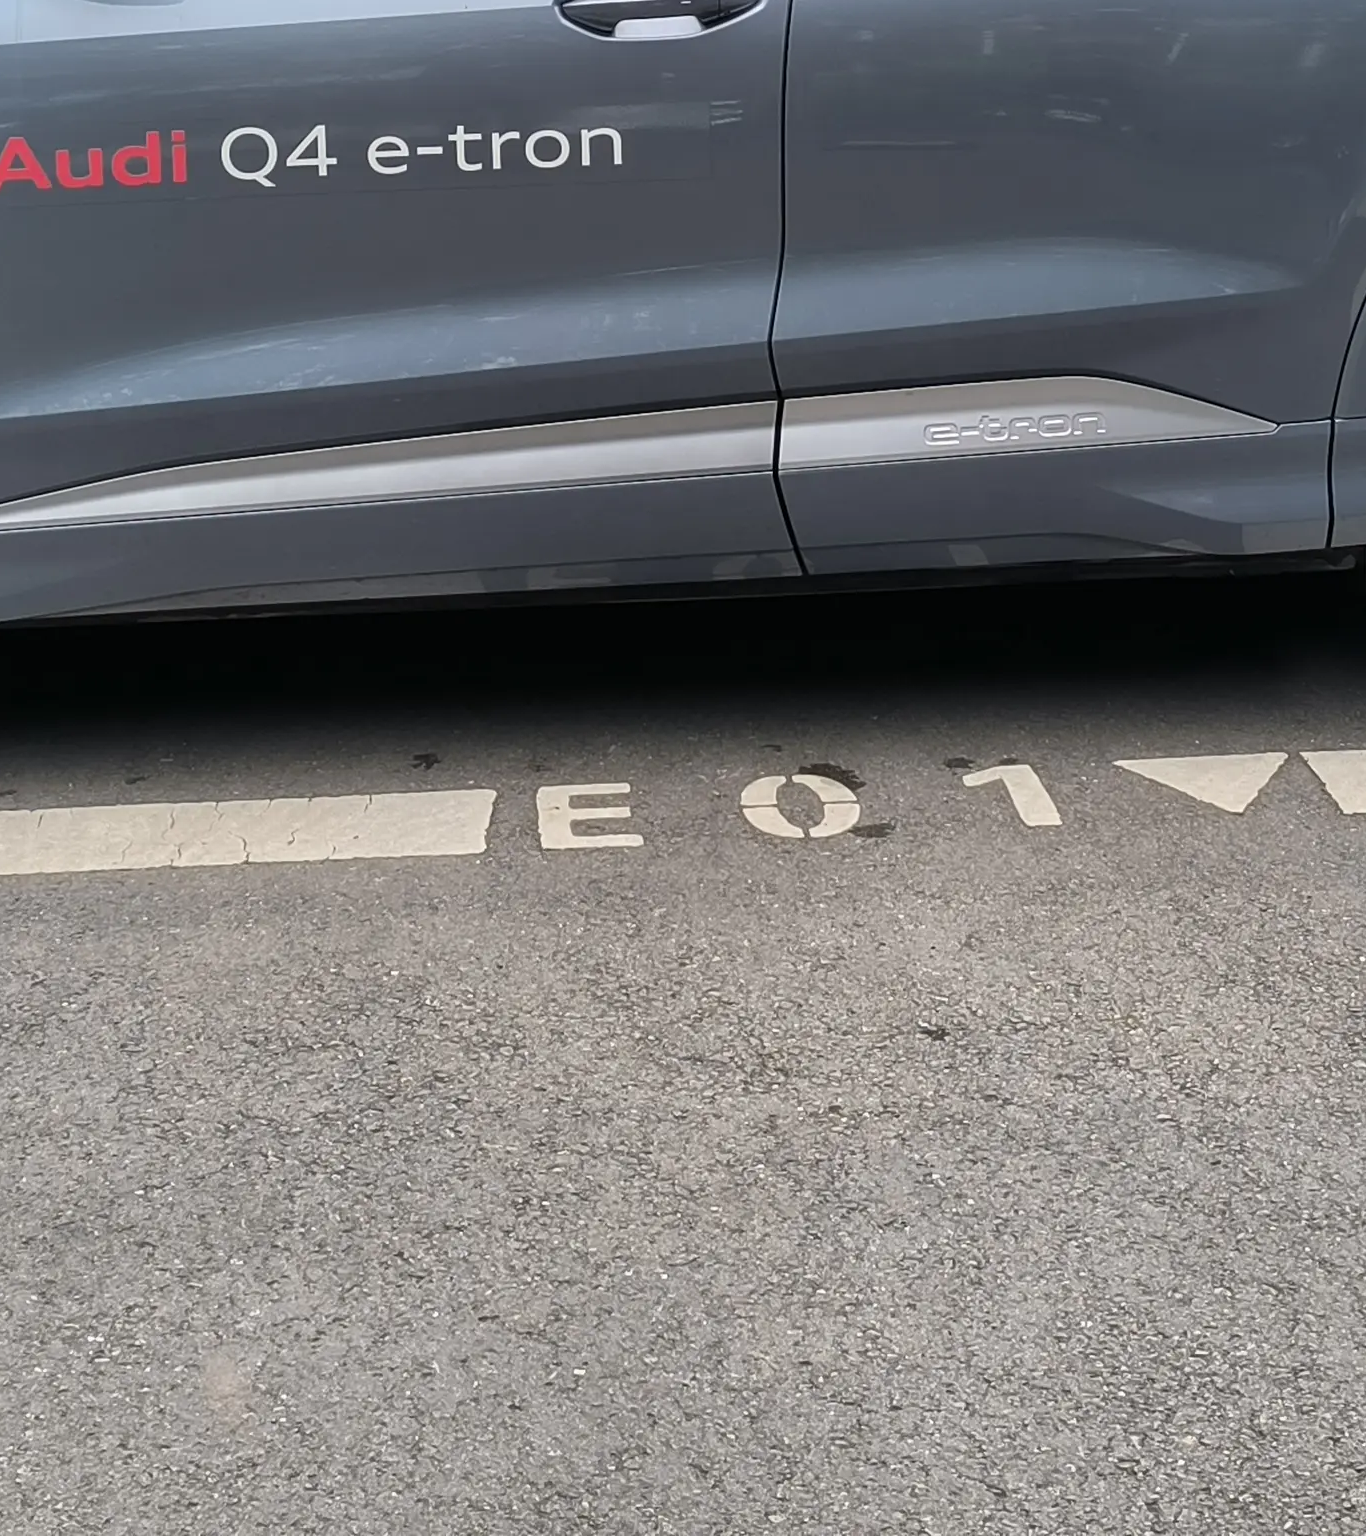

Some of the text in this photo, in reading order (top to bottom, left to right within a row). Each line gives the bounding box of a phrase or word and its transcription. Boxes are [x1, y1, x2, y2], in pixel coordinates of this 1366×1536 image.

[220, 124, 337, 187] Q4
[366, 124, 623, 175] e-tron
[923, 411, 1106, 446] e-tron
